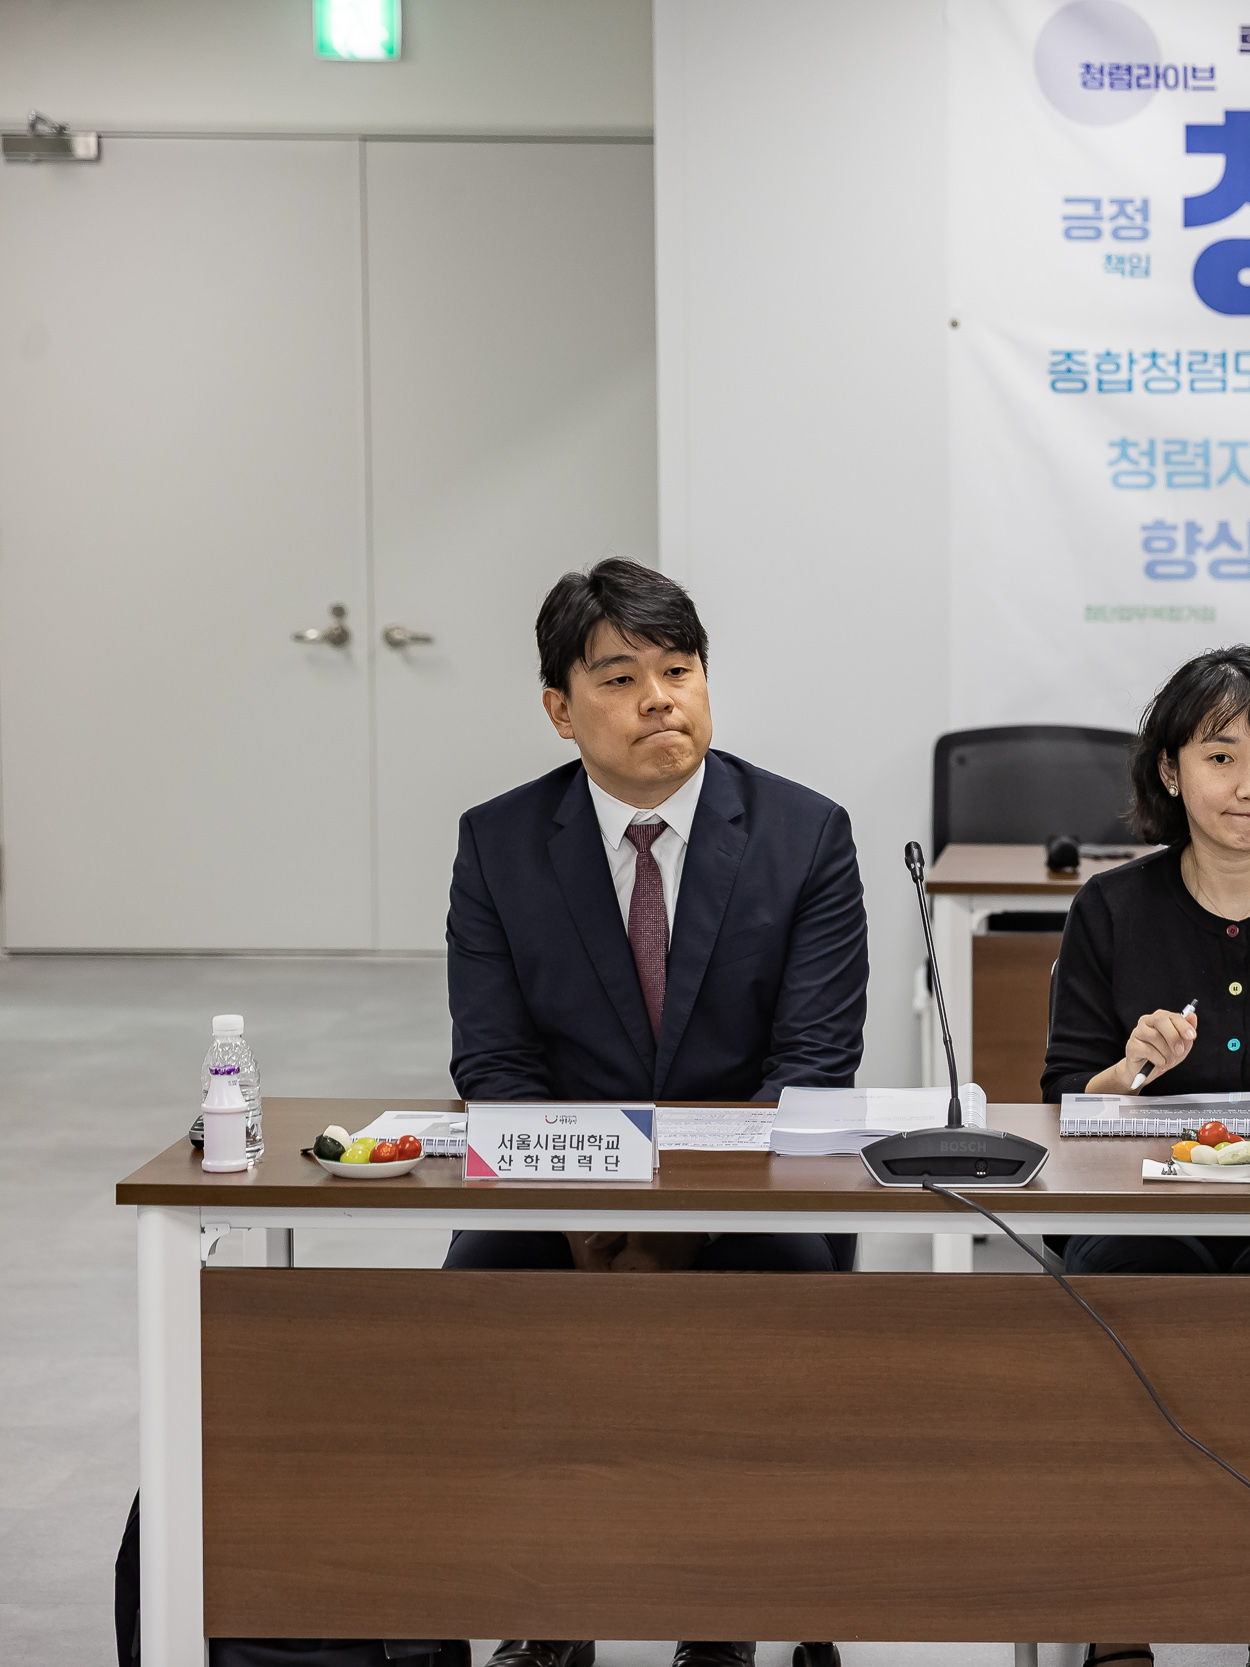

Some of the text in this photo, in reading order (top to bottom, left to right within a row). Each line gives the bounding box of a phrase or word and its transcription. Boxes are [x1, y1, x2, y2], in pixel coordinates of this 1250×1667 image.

[1080, 61, 1216, 92] 청렴라이브
[1061, 196, 1152, 242] 긍정
[1104, 252, 1151, 279] 책임
[497, 1133, 621, 1151] 서울시립대학교
[940, 1141, 986, 1153] BOSCH
